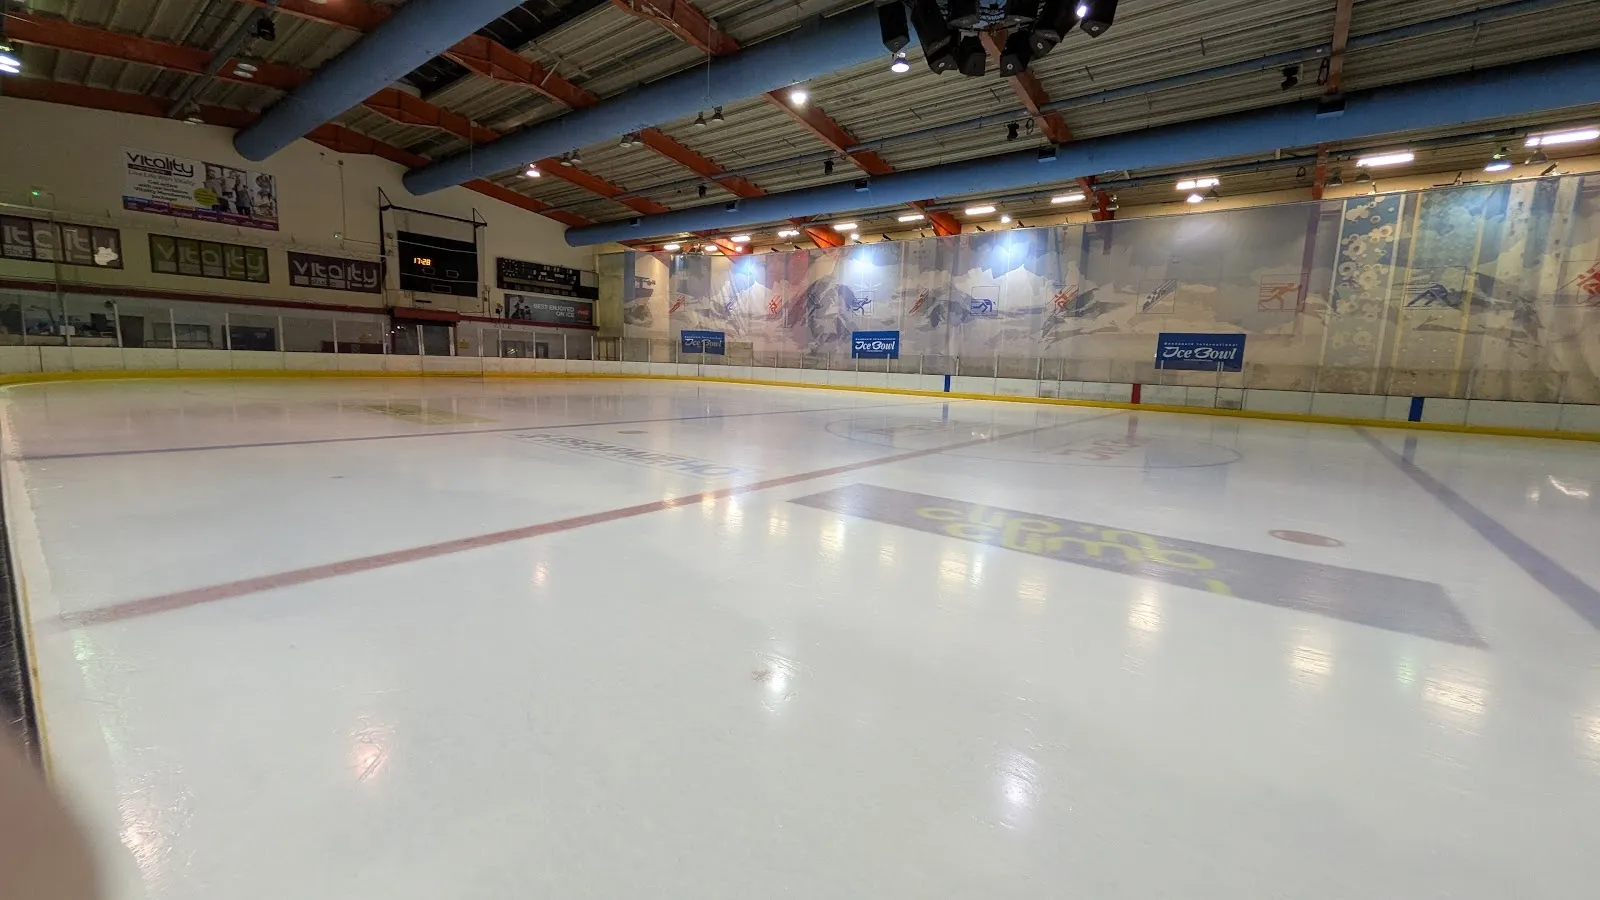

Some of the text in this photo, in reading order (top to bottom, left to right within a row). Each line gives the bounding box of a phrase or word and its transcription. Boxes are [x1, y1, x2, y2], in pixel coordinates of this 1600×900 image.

[413, 257, 431, 266] 17:28
[855, 341, 896, 350] Ice Bowl
[1163, 346, 1238, 360] Ice Bowl
